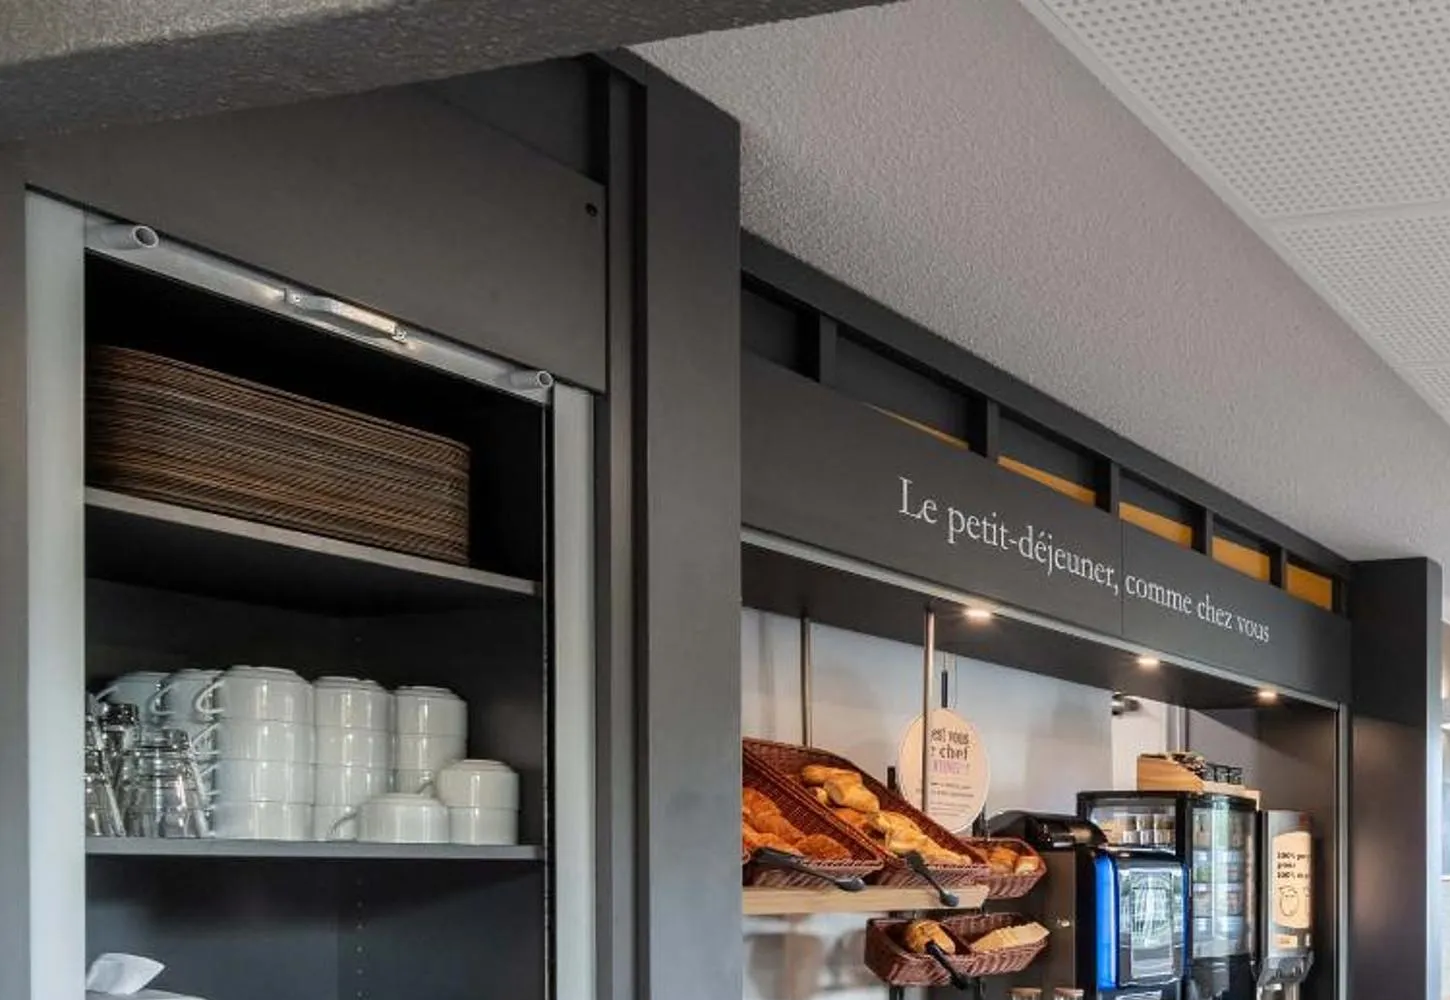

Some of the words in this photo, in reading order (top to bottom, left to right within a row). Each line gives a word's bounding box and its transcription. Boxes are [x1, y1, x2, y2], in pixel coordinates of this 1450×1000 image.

[899, 476, 938, 524] Le
[946, 508, 1119, 596] petit-déjeuner,
[1124, 572, 1193, 615] comme
[1197, 595, 1234, 631] chez
[1236, 616, 1270, 643] vous
